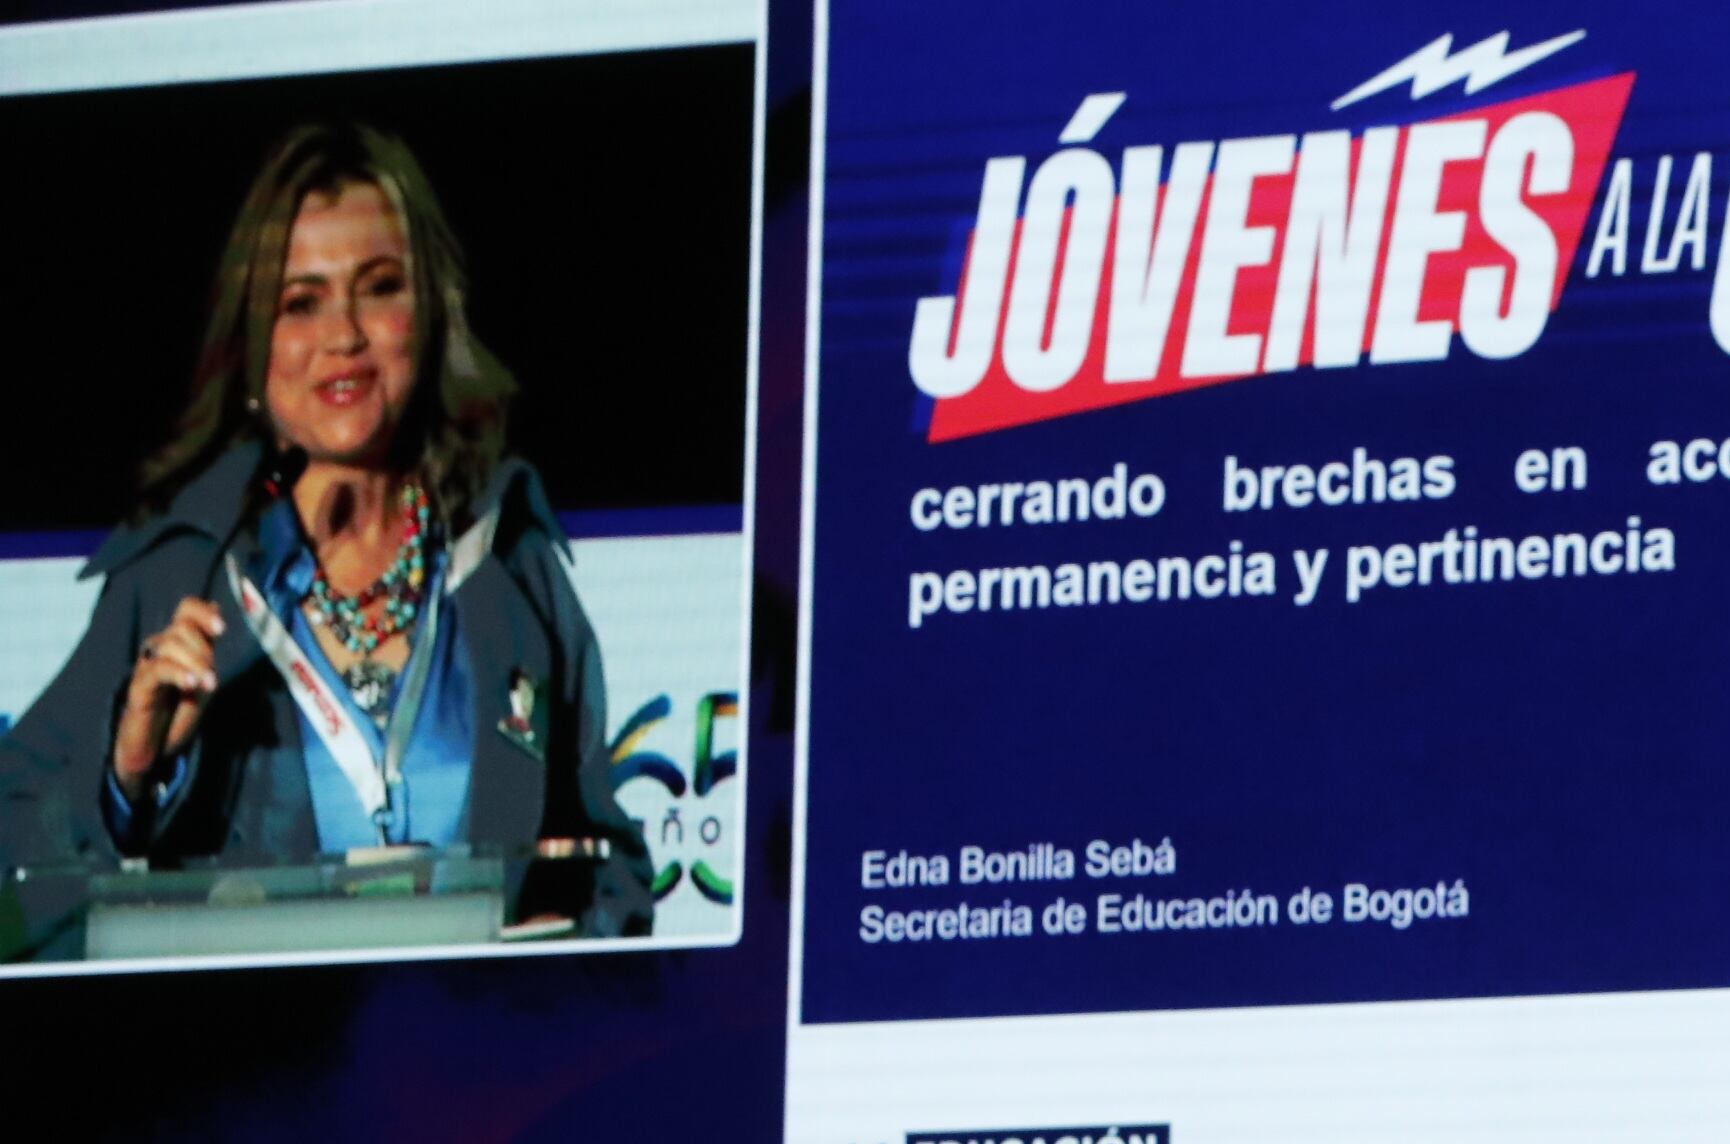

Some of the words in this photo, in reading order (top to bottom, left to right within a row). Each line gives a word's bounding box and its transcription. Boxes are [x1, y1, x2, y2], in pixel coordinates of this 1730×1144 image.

[908, 91, 1575, 399] JÓVENES
[1586, 157, 1632, 278] A
[1640, 152, 1712, 273] LA
[910, 462, 1165, 530] cerrando
[1223, 447, 1456, 511] brechas
[1514, 446, 1587, 493] en
[908, 540, 1276, 628] permanencia
[1293, 548, 1329, 606] y
[1346, 516, 1675, 603] pertinencia
[861, 850, 950, 888] Edna
[959, 843, 1075, 883] Bonilla
[1085, 837, 1176, 878] Sebá
[859, 899, 1033, 943] Secretaria
[1042, 897, 1087, 935] de
[1097, 889, 1279, 932] Educación
[1287, 886, 1334, 924] de
[1343, 879, 1469, 929] Bogotá
